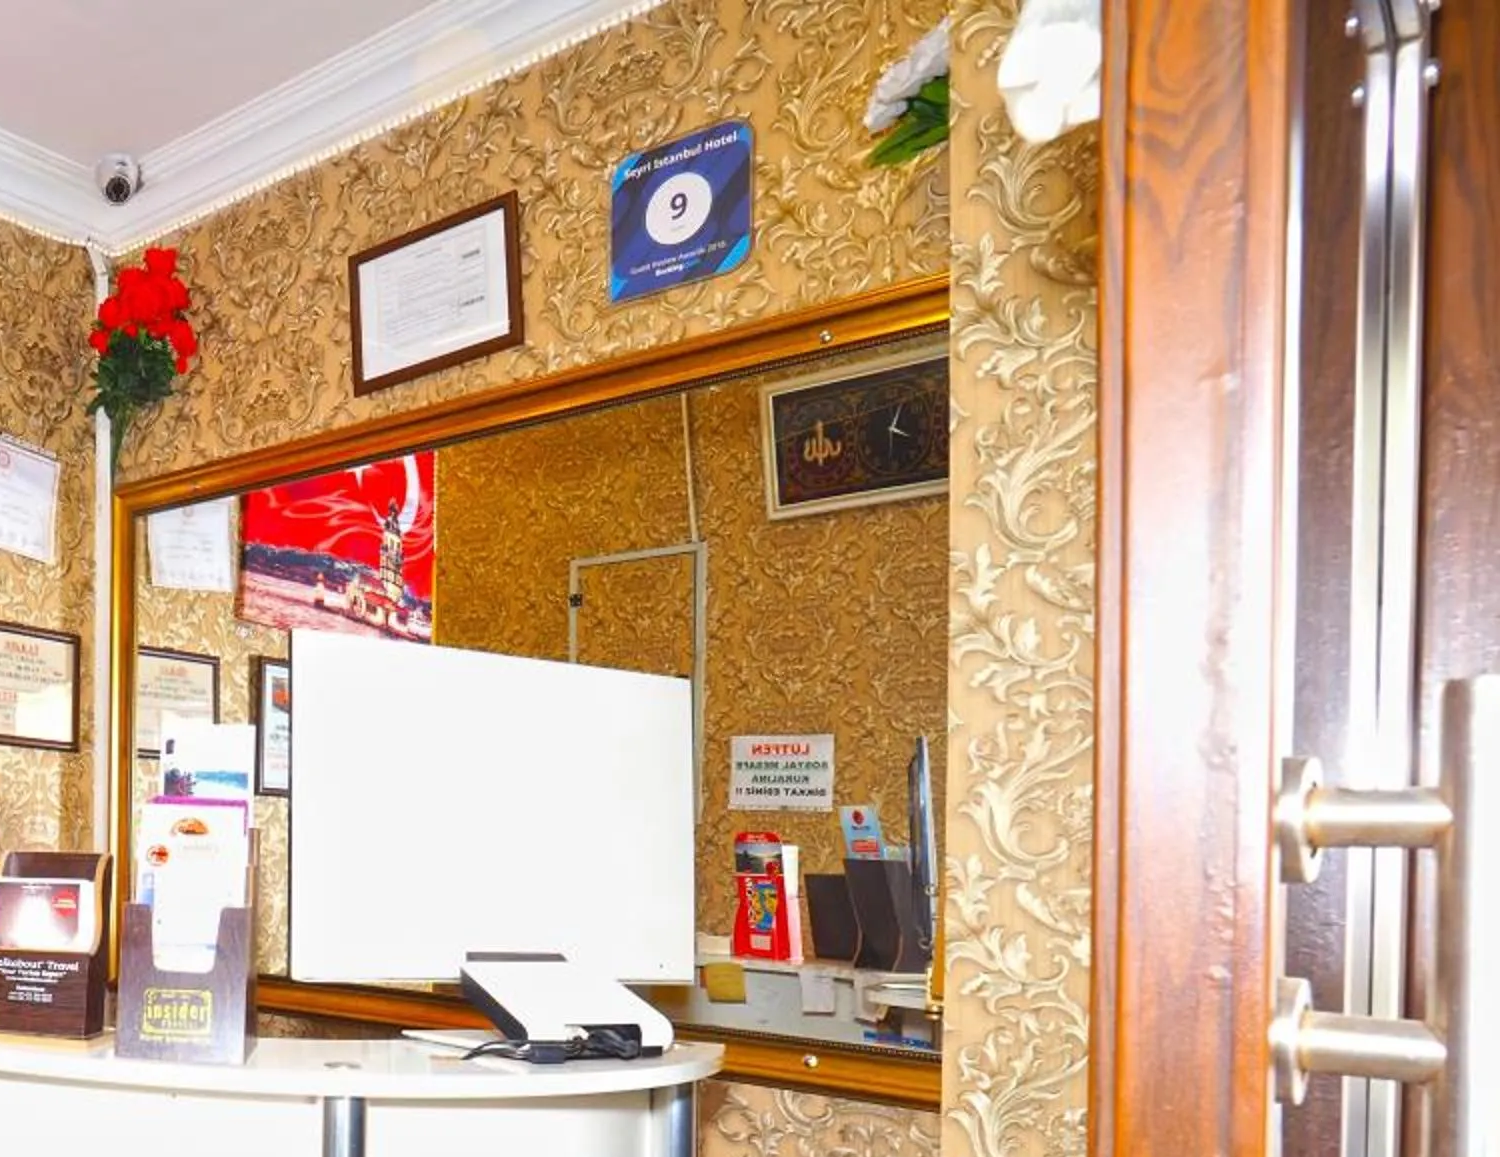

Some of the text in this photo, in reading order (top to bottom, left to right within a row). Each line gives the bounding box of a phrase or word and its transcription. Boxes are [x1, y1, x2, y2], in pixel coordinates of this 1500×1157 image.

[704, 130, 738, 151] Hotel
[669, 192, 688, 220] 9
[47, 960, 79, 972] Travel
